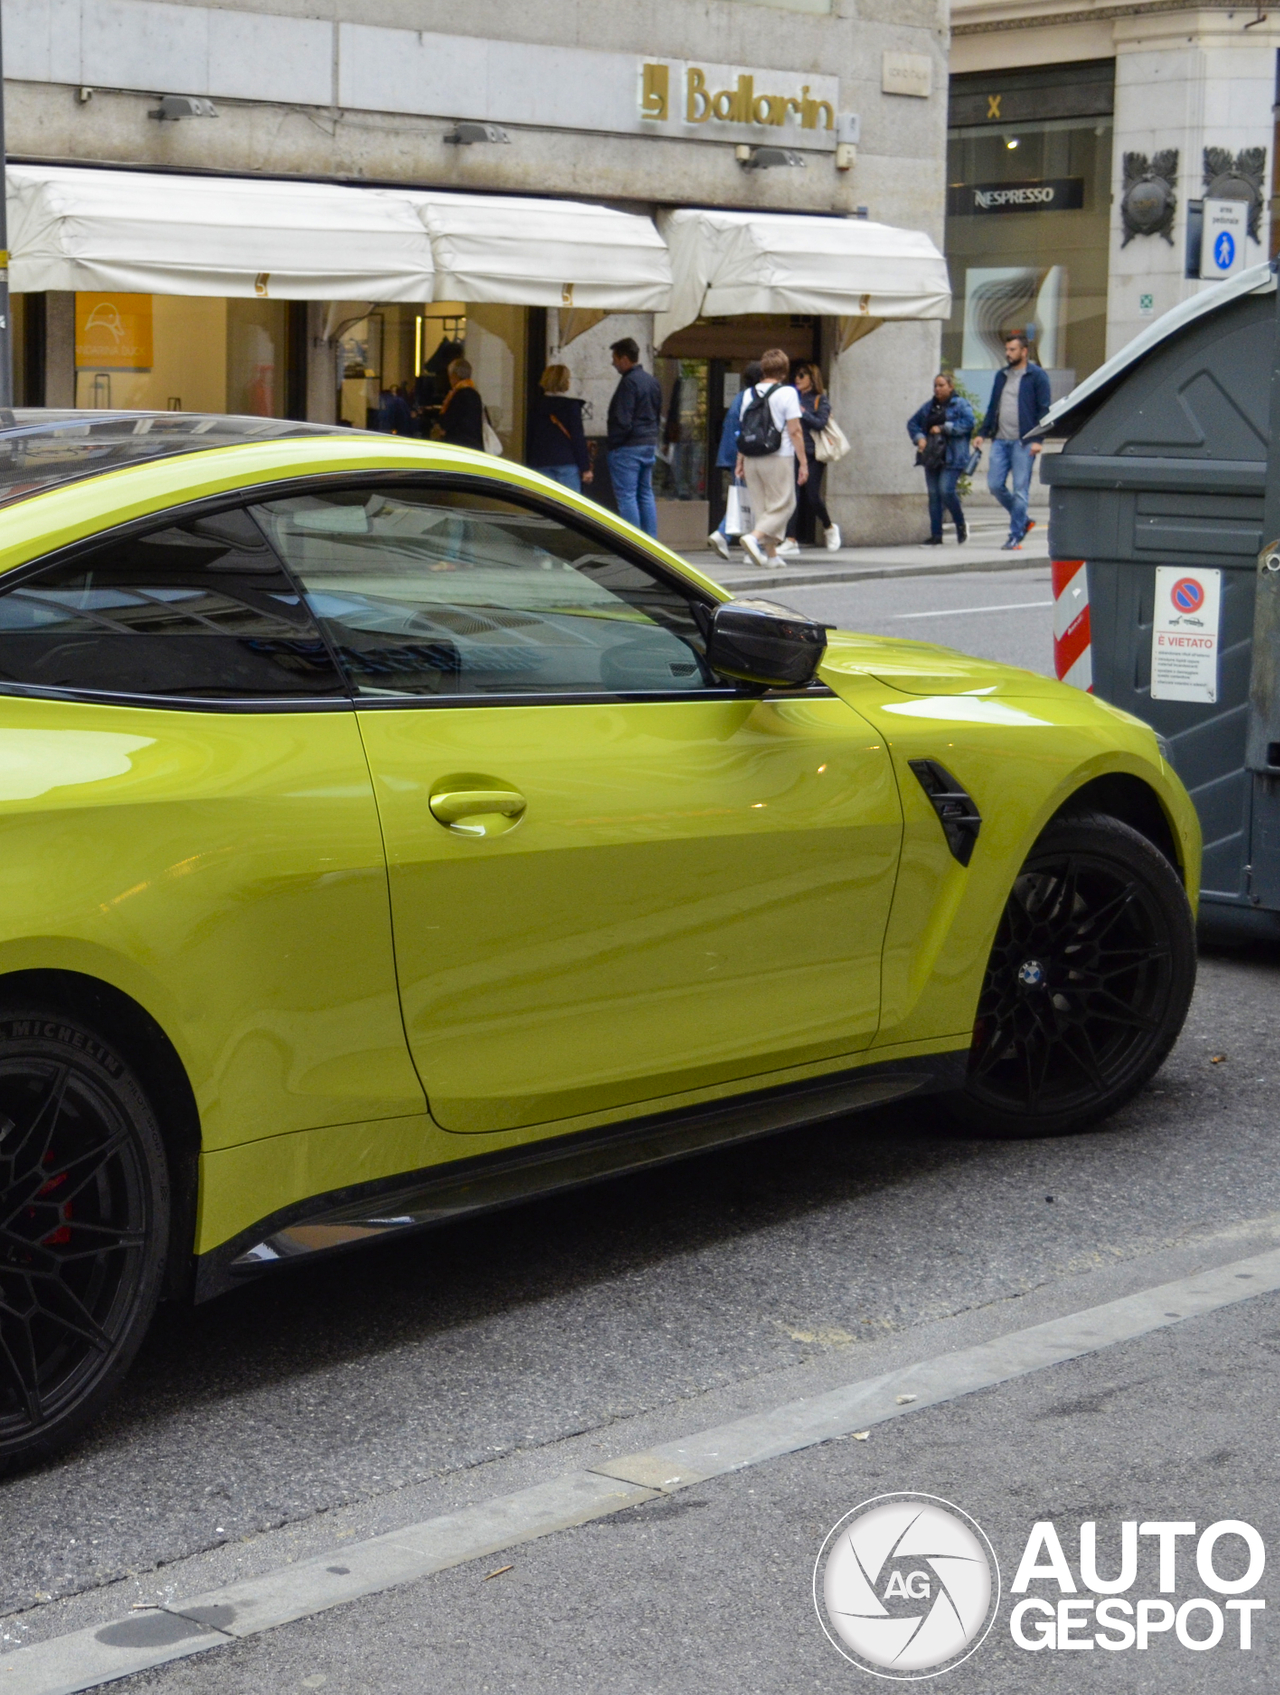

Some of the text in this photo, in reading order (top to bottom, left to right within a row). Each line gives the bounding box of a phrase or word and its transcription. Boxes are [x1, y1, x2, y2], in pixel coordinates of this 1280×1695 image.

[685, 67, 834, 130] Ballarin
[972, 187, 1054, 209] NESPRESSO
[1158, 634, 1213, 649] È VIETATO
[11, 1020, 121, 1074] MICHELIN
[127, 1080, 148, 1111] PILOT
